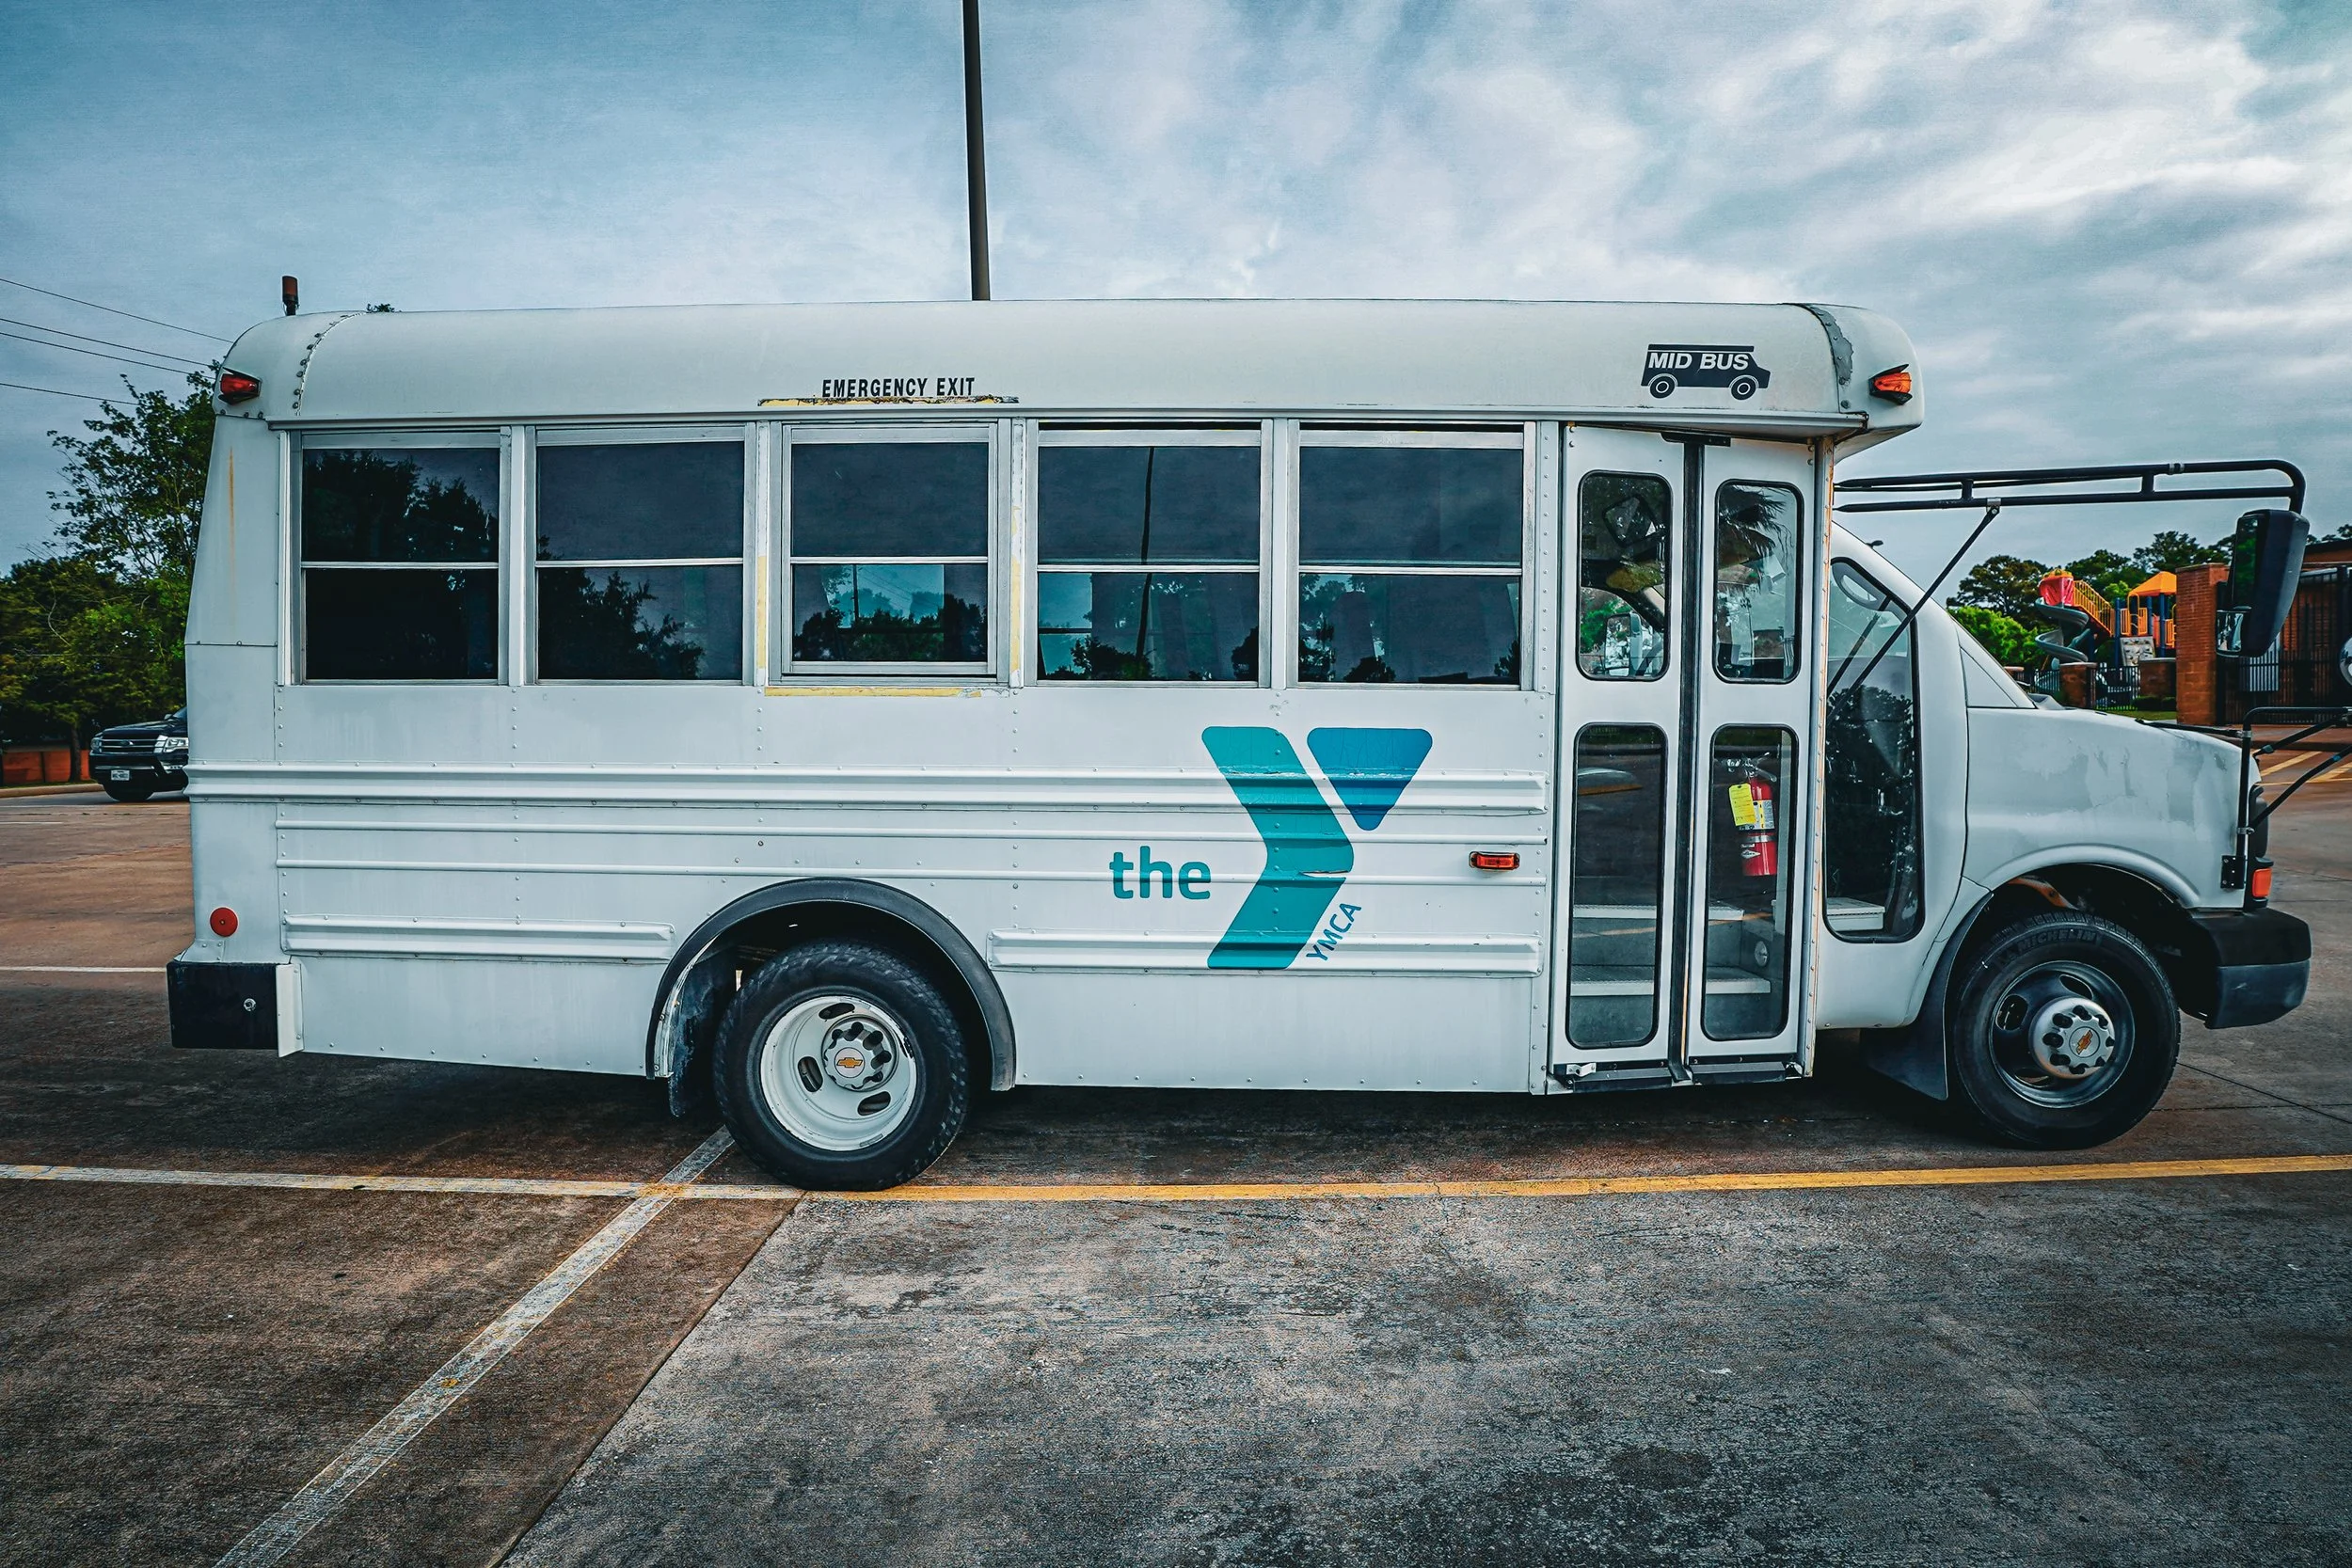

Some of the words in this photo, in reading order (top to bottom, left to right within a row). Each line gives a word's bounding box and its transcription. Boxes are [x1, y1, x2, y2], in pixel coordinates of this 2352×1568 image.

[1647, 352, 1692, 369] MID
[1699, 354, 1749, 371] BUS
[821, 378, 928, 397] EMERGENCY
[936, 377, 975, 396] EXIT
[1109, 846, 1211, 899] the
[1306, 902, 1362, 961] YMCA
[2018, 929, 2097, 950] MICHELIN
